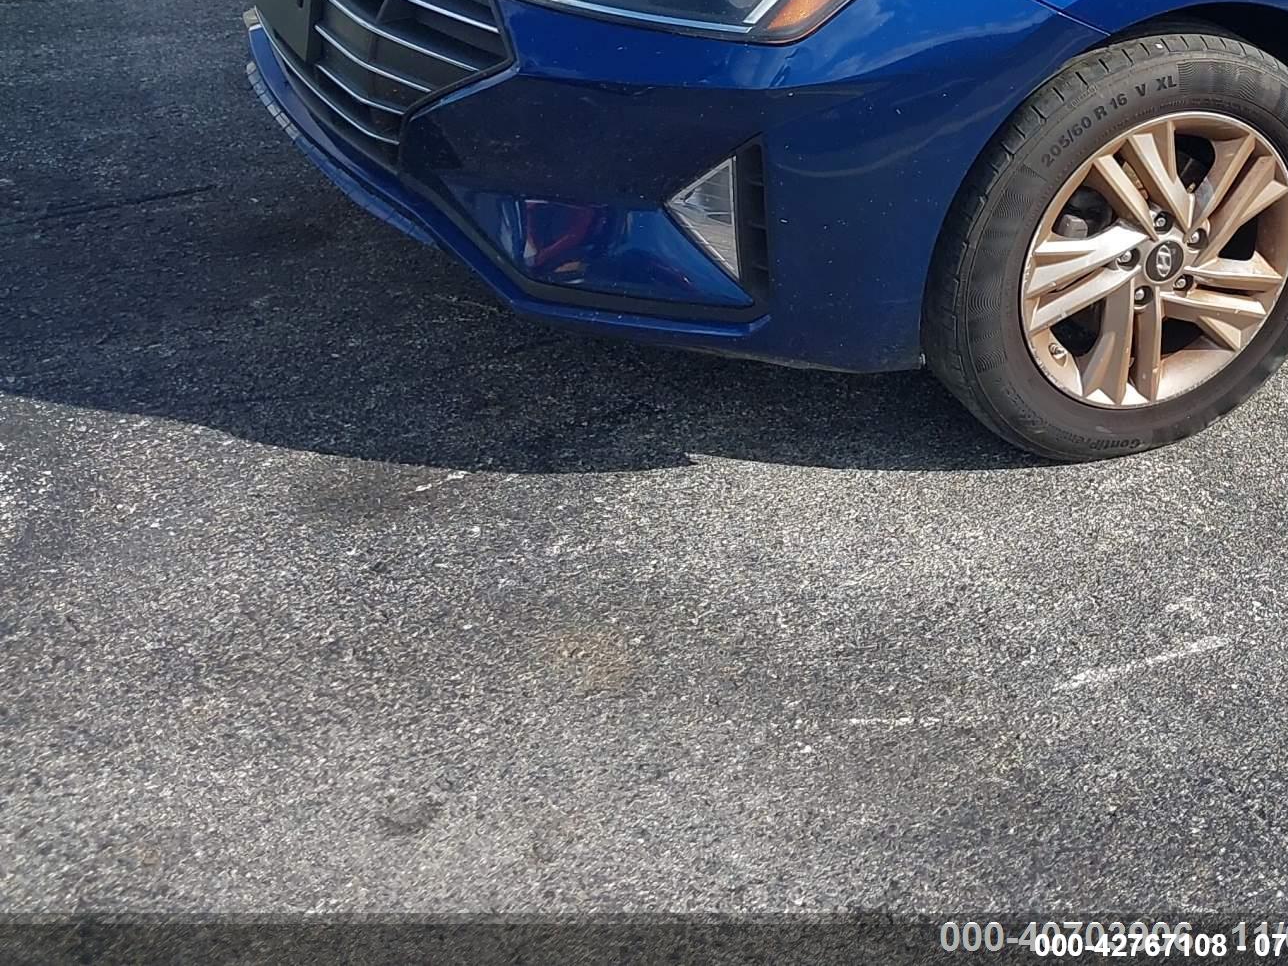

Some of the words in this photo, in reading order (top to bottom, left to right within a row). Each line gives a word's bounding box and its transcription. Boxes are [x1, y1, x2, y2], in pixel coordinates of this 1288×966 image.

[1041, 116, 1092, 167] 205/60
[1093, 105, 1108, 121] R
[1110, 93, 1128, 110] 16
[1135, 84, 1147, 97] V
[1156, 75, 1177, 91] XL
